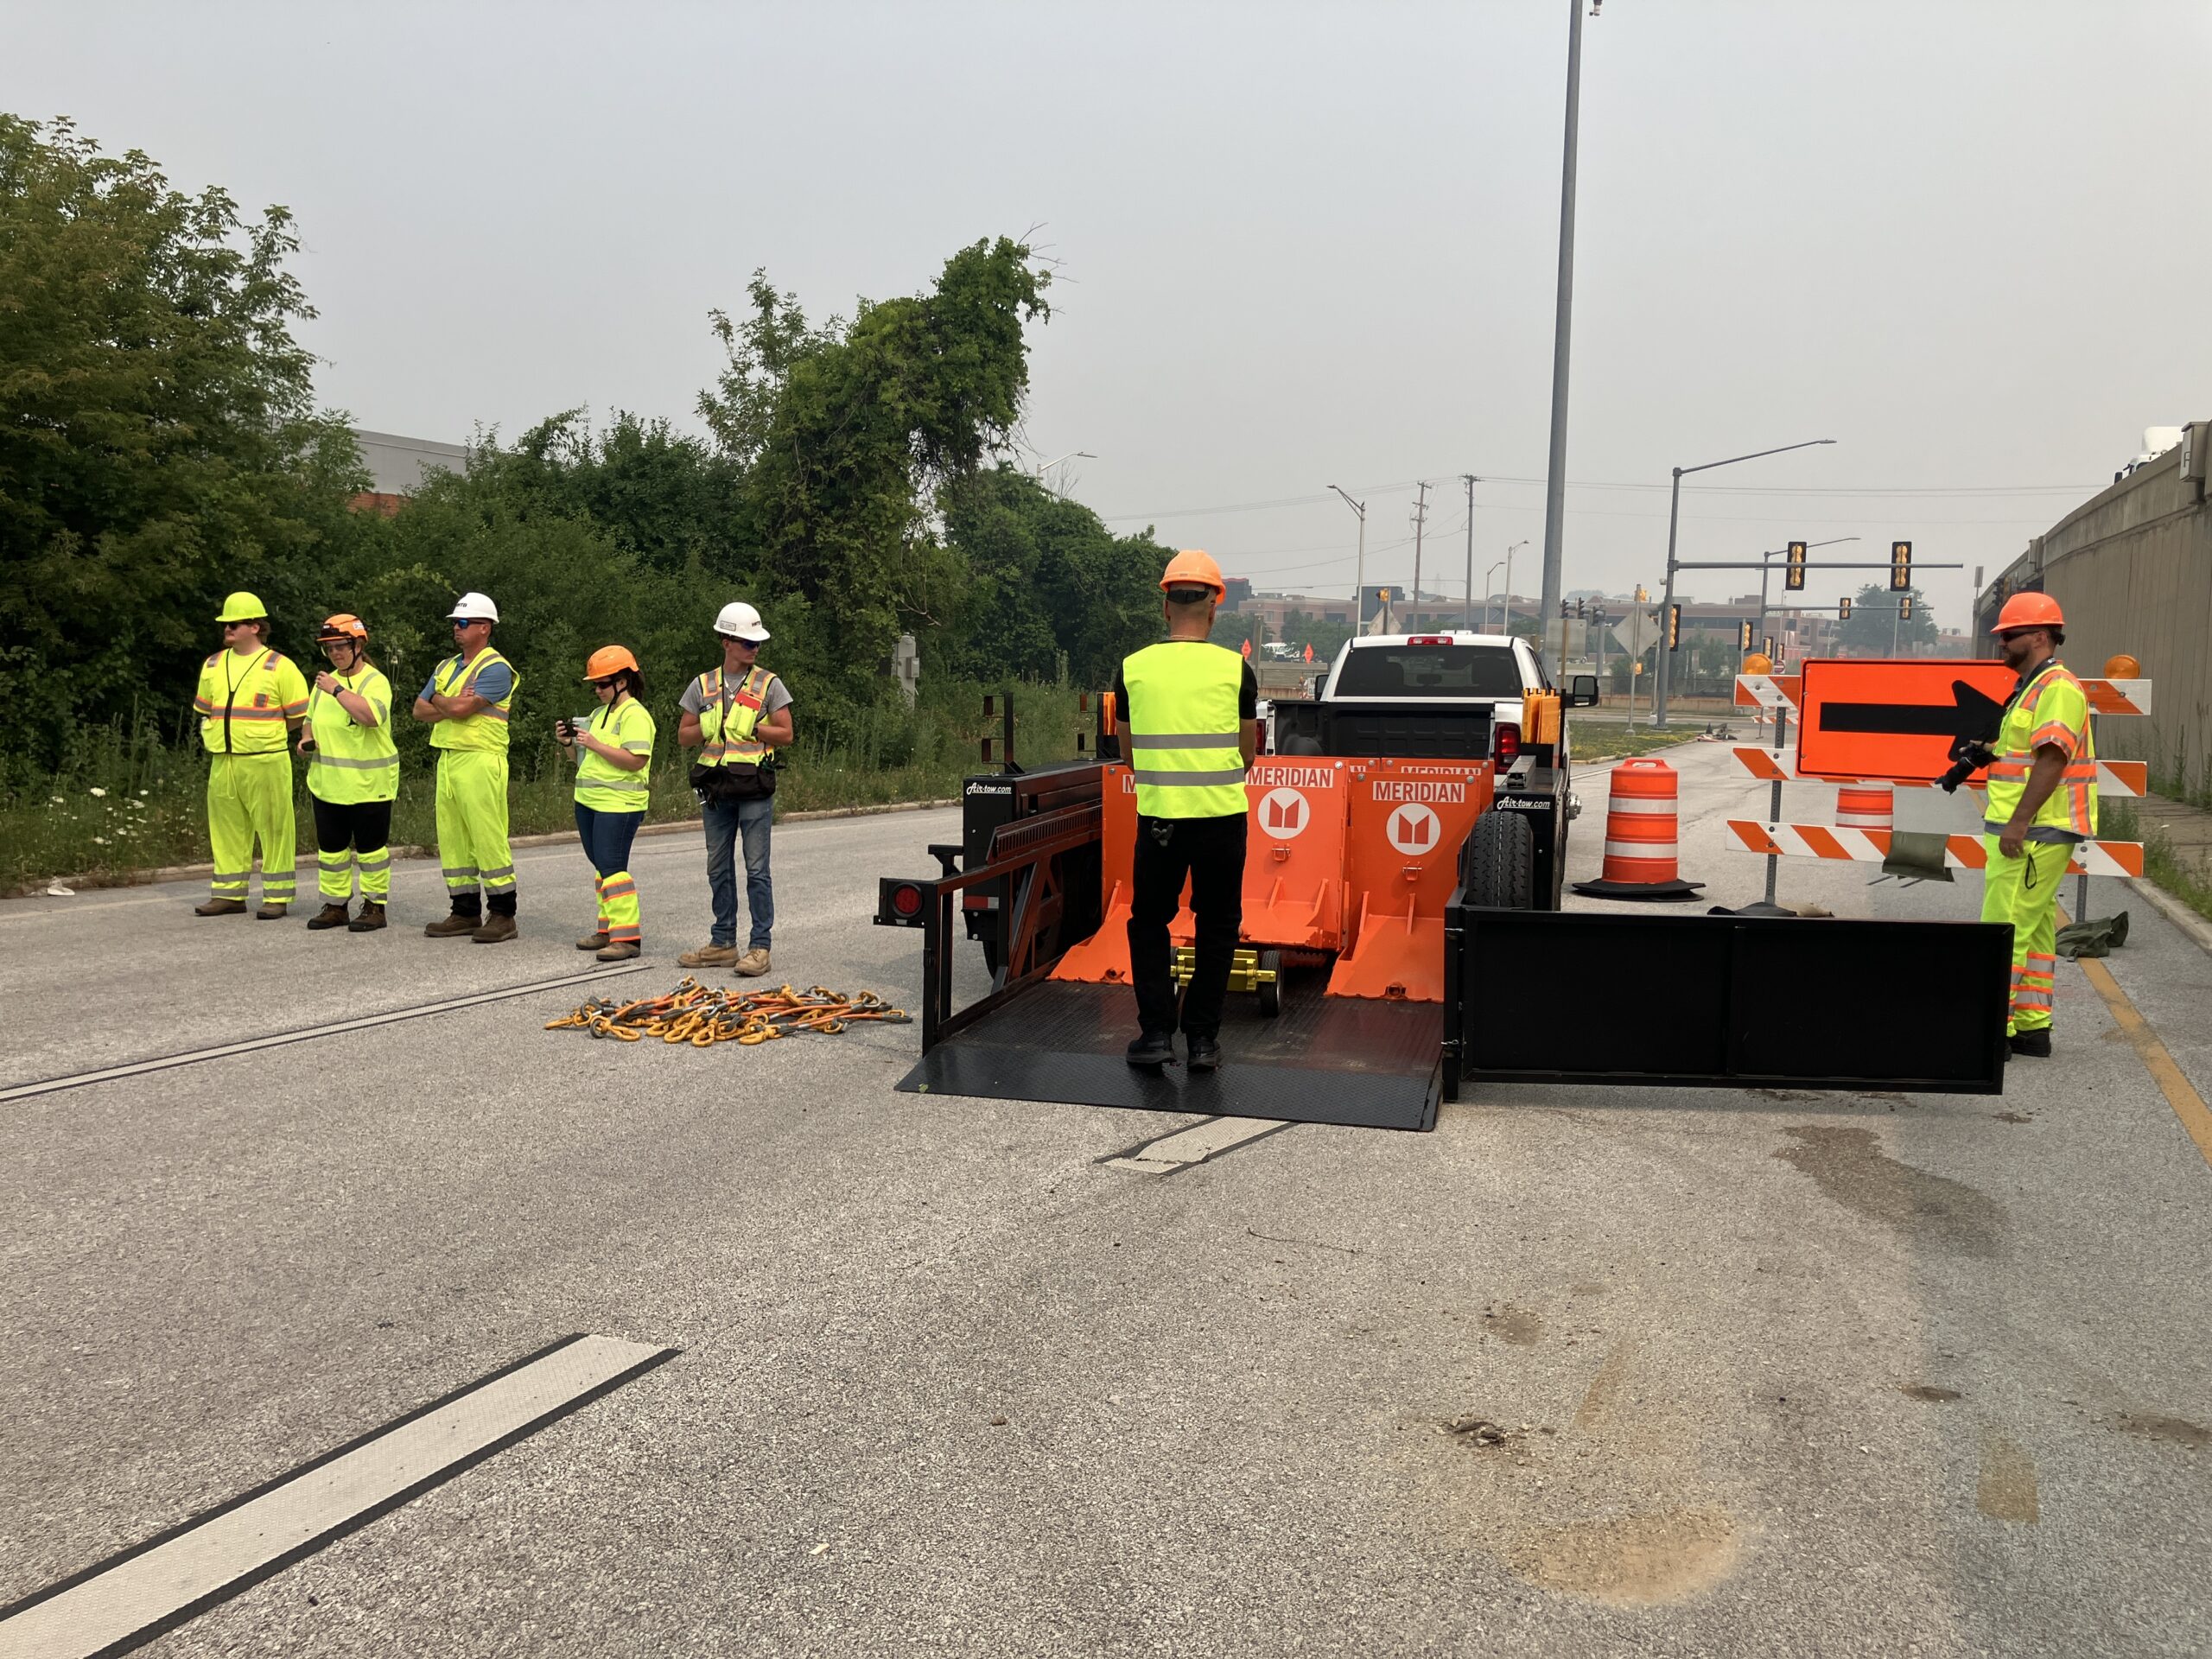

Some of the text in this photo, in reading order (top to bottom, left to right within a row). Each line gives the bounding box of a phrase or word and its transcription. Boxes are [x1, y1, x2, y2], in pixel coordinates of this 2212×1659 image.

[1248, 767, 1331, 787] MERIDIAN
[966, 782, 1012, 795] Air-tow.com
[1376, 782, 1462, 802] MERIDIAN
[1497, 796, 1551, 810] Air-tow.com
